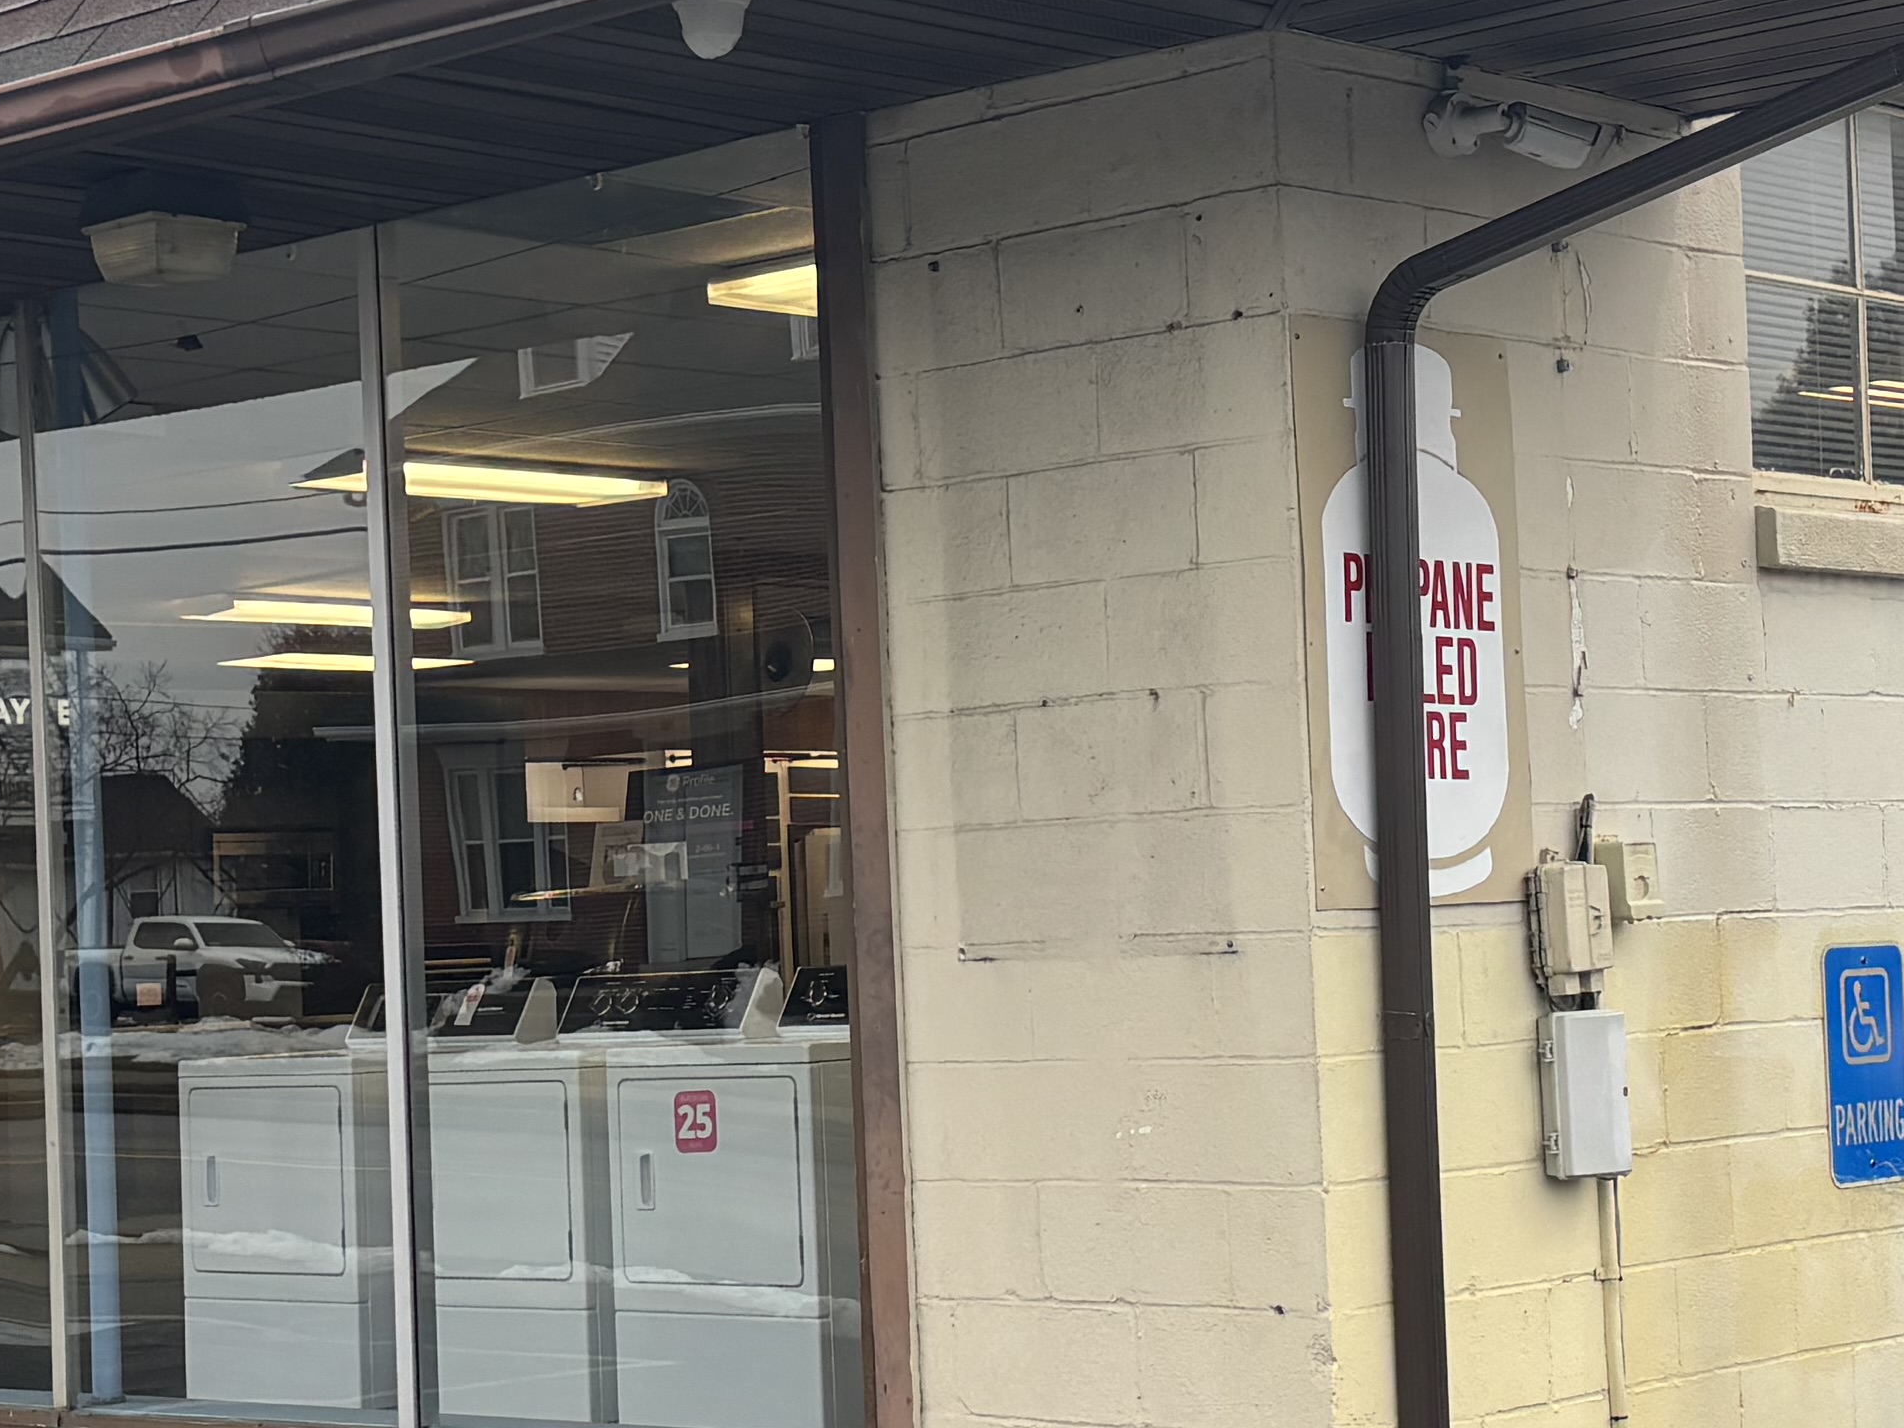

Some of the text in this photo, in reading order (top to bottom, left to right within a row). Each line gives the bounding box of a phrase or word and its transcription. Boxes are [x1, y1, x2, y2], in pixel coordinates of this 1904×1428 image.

[643, 802, 735, 824] ONE & DONE.
[677, 1103, 713, 1140] 25
